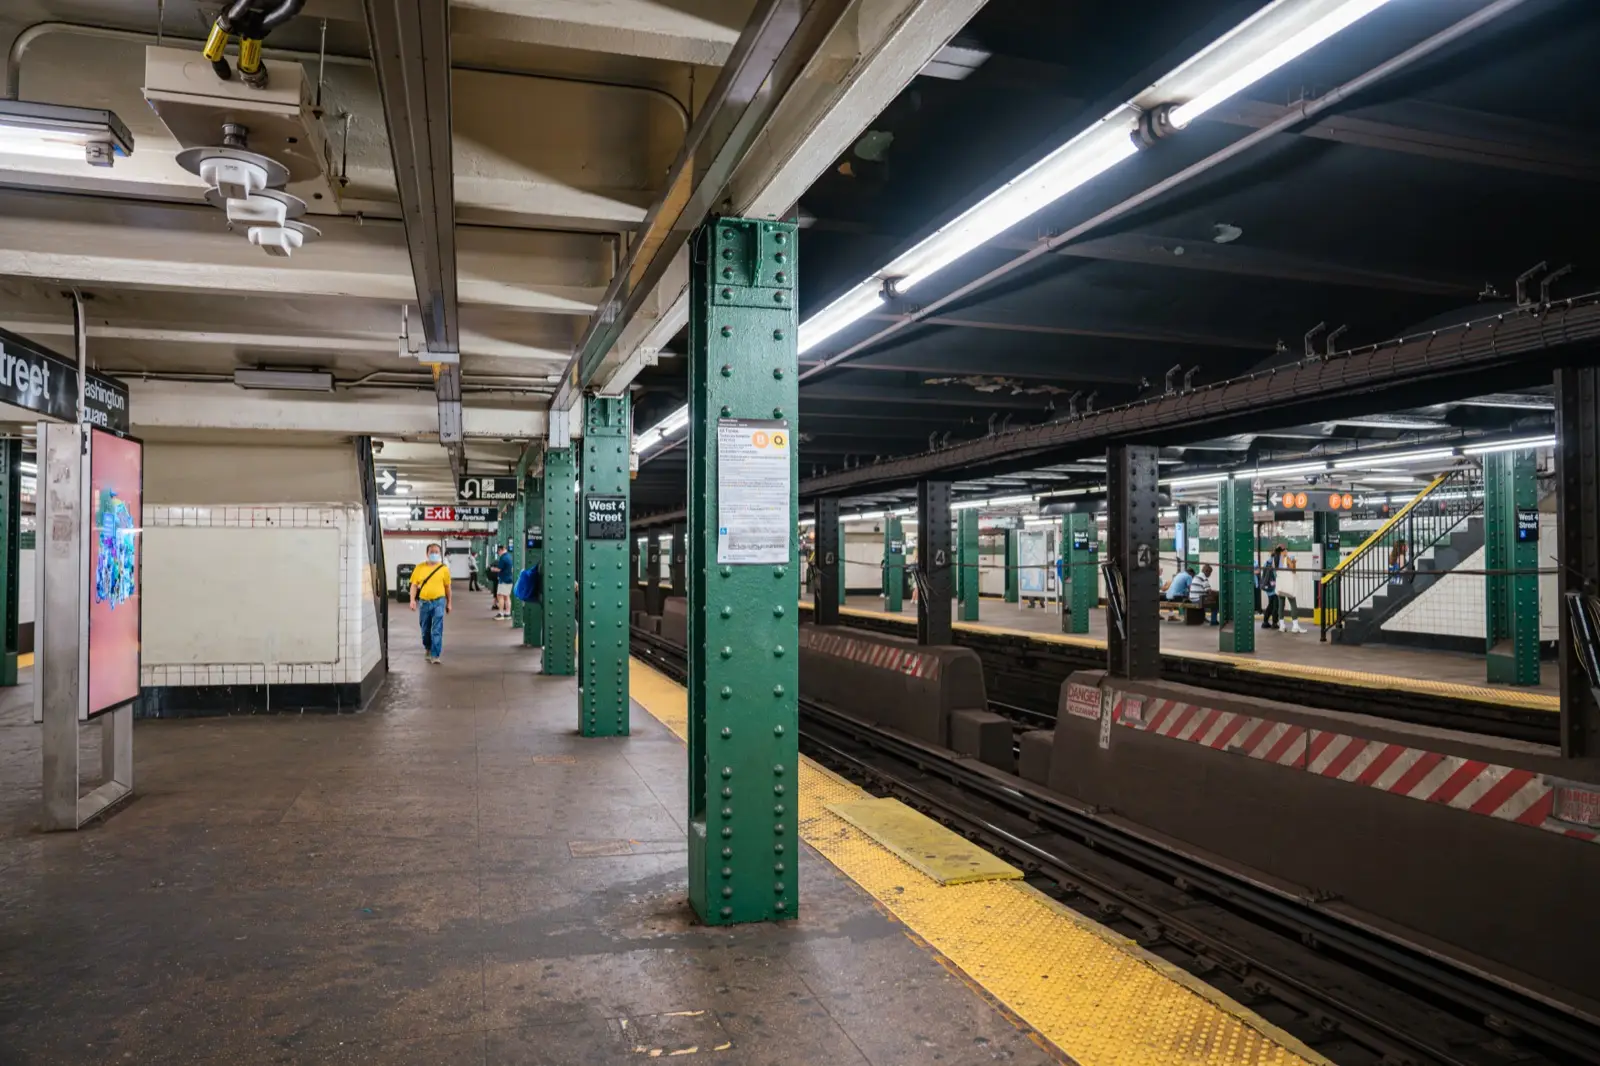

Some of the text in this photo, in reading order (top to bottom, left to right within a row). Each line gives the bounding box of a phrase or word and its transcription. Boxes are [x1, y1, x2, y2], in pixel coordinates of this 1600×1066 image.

[774, 435, 784, 446] Q
[481, 491, 516, 500] Escalator
[454, 507, 471, 515] West
[481, 507, 490, 515] St
[589, 500, 626, 511] West 4
[424, 507, 451, 520] Exit
[589, 511, 622, 522] Street
[1518, 513, 1534, 521] West
[1519, 521, 1537, 529] Street
[1068, 685, 1100, 706] DANGER
